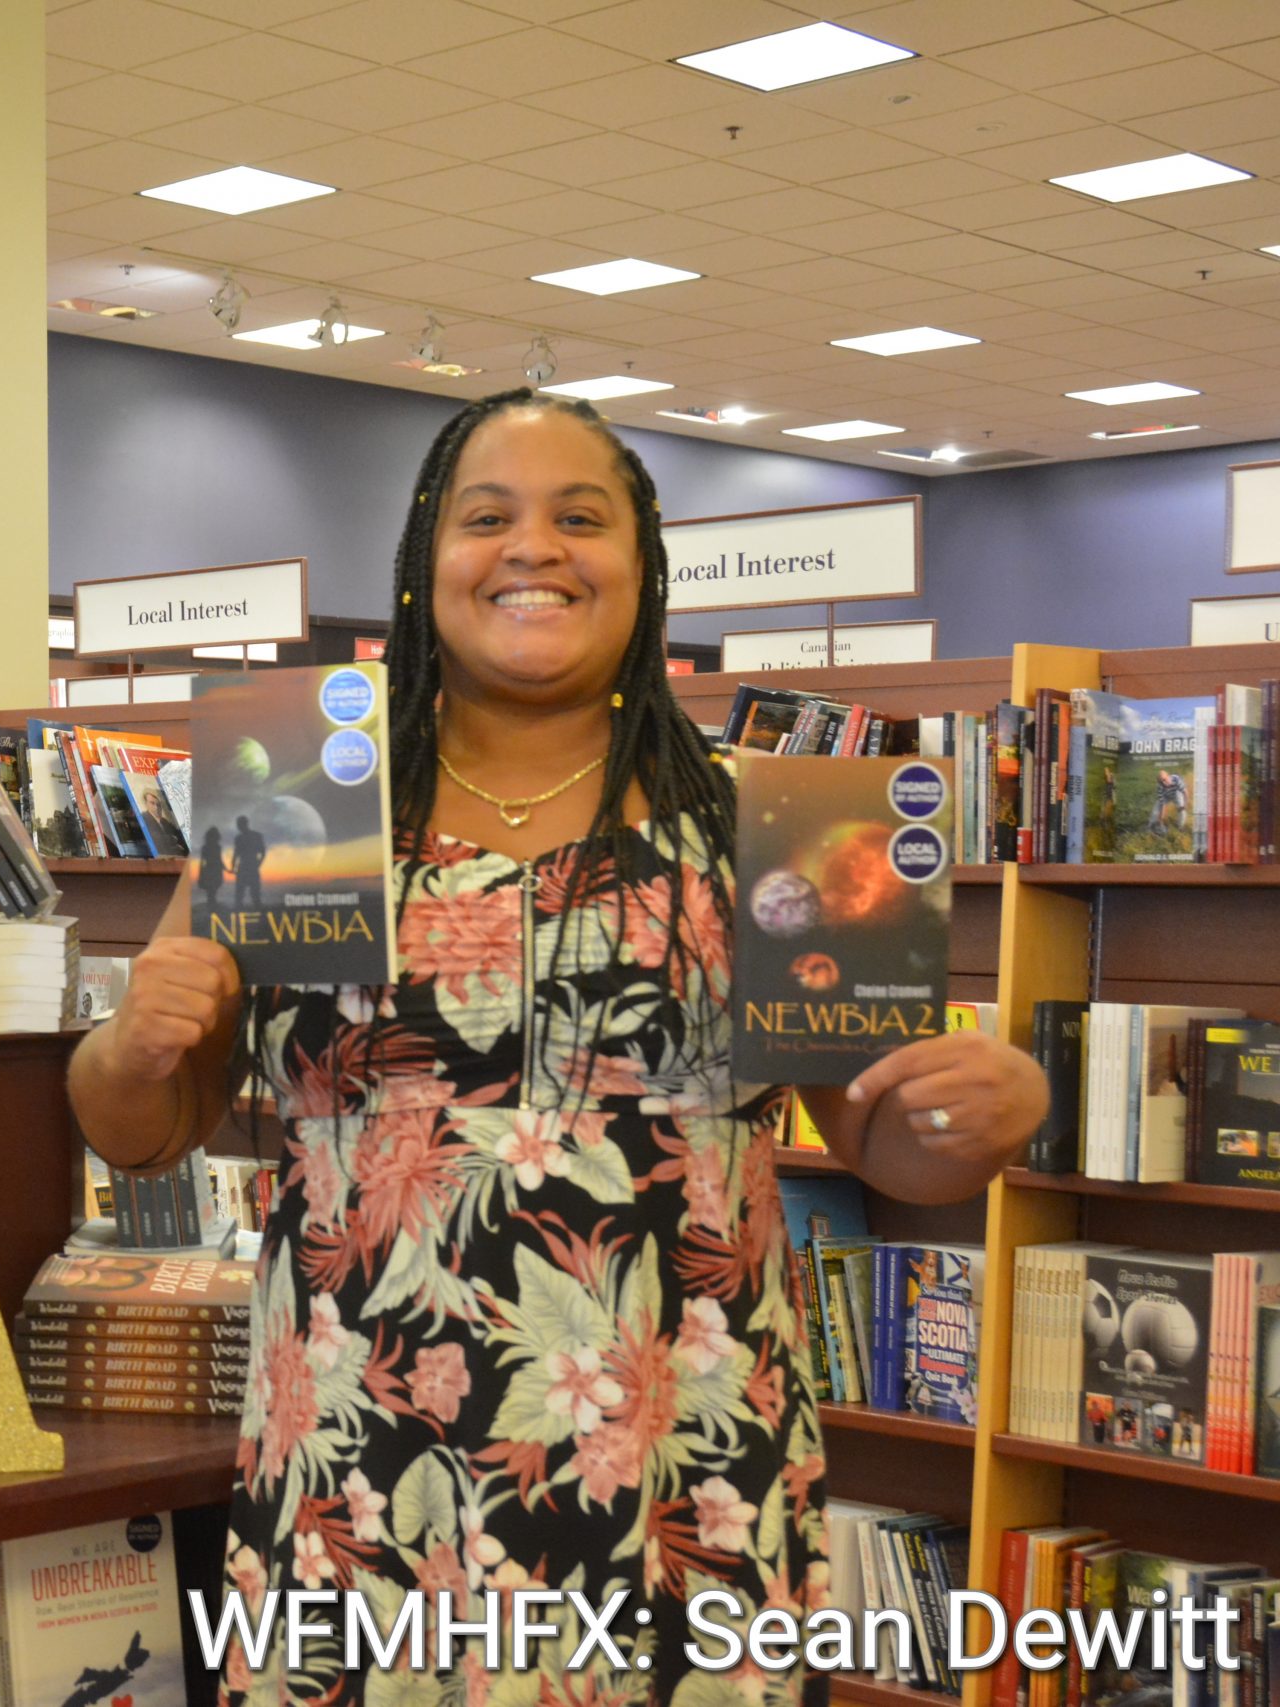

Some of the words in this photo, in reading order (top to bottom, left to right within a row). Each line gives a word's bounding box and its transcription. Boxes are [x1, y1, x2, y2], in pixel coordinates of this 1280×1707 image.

[735, 547, 836, 578] Interest
[128, 602, 172, 626] Local
[180, 598, 248, 621] Interest
[800, 641, 852, 654] Canaian
[331, 747, 368, 758] LOCAL
[1129, 740, 1161, 754] JOHN
[1164, 739, 1196, 753] BRAG
[895, 781, 942, 794] SIGNED
[897, 843, 937, 855] LOCAL
[898, 855, 938, 866] AUTHOR
[210, 910, 375, 945] NEWBIA
[745, 1001, 910, 1035] NEWBIA
[915, 1004, 938, 1035] 2
[1238, 1055, 1272, 1072] WE
[181, 1260, 217, 1292] ROAD
[936, 1302, 967, 1326] NOVA
[919, 1321, 968, 1350] SCOTIA
[929, 1349, 965, 1364] ULTIMATE
[71, 1544, 87, 1556] WE
[95, 1540, 116, 1554] ARE
[31, 1553, 157, 1602] UNBREAKABLE
